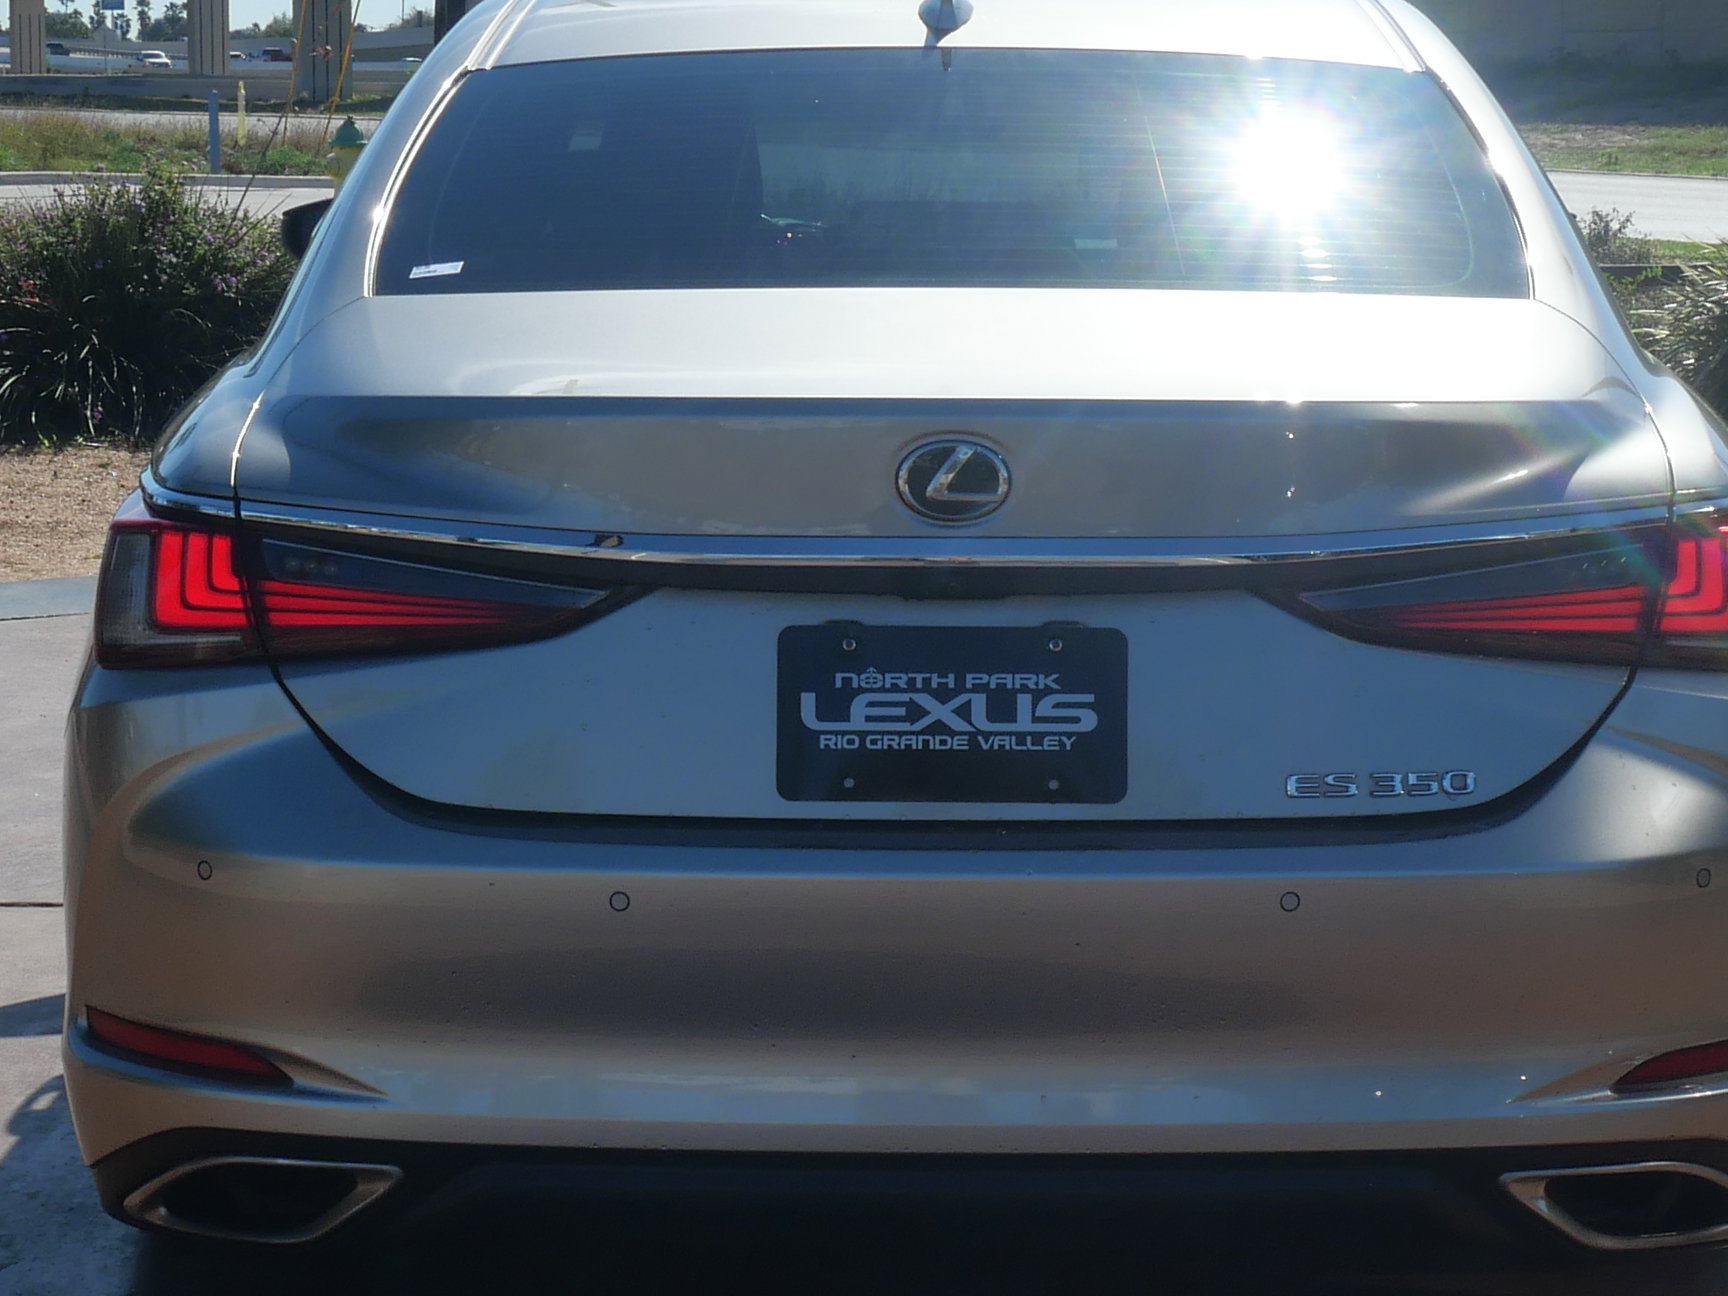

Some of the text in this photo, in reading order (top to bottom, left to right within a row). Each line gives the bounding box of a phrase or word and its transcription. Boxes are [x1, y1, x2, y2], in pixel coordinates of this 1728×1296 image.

[965, 673, 1062, 689] PARK
[800, 692, 1098, 733] LEXUS
[819, 734, 1077, 751] RIO GRANDE VALLEY
[1286, 770, 1477, 798] ES 350
